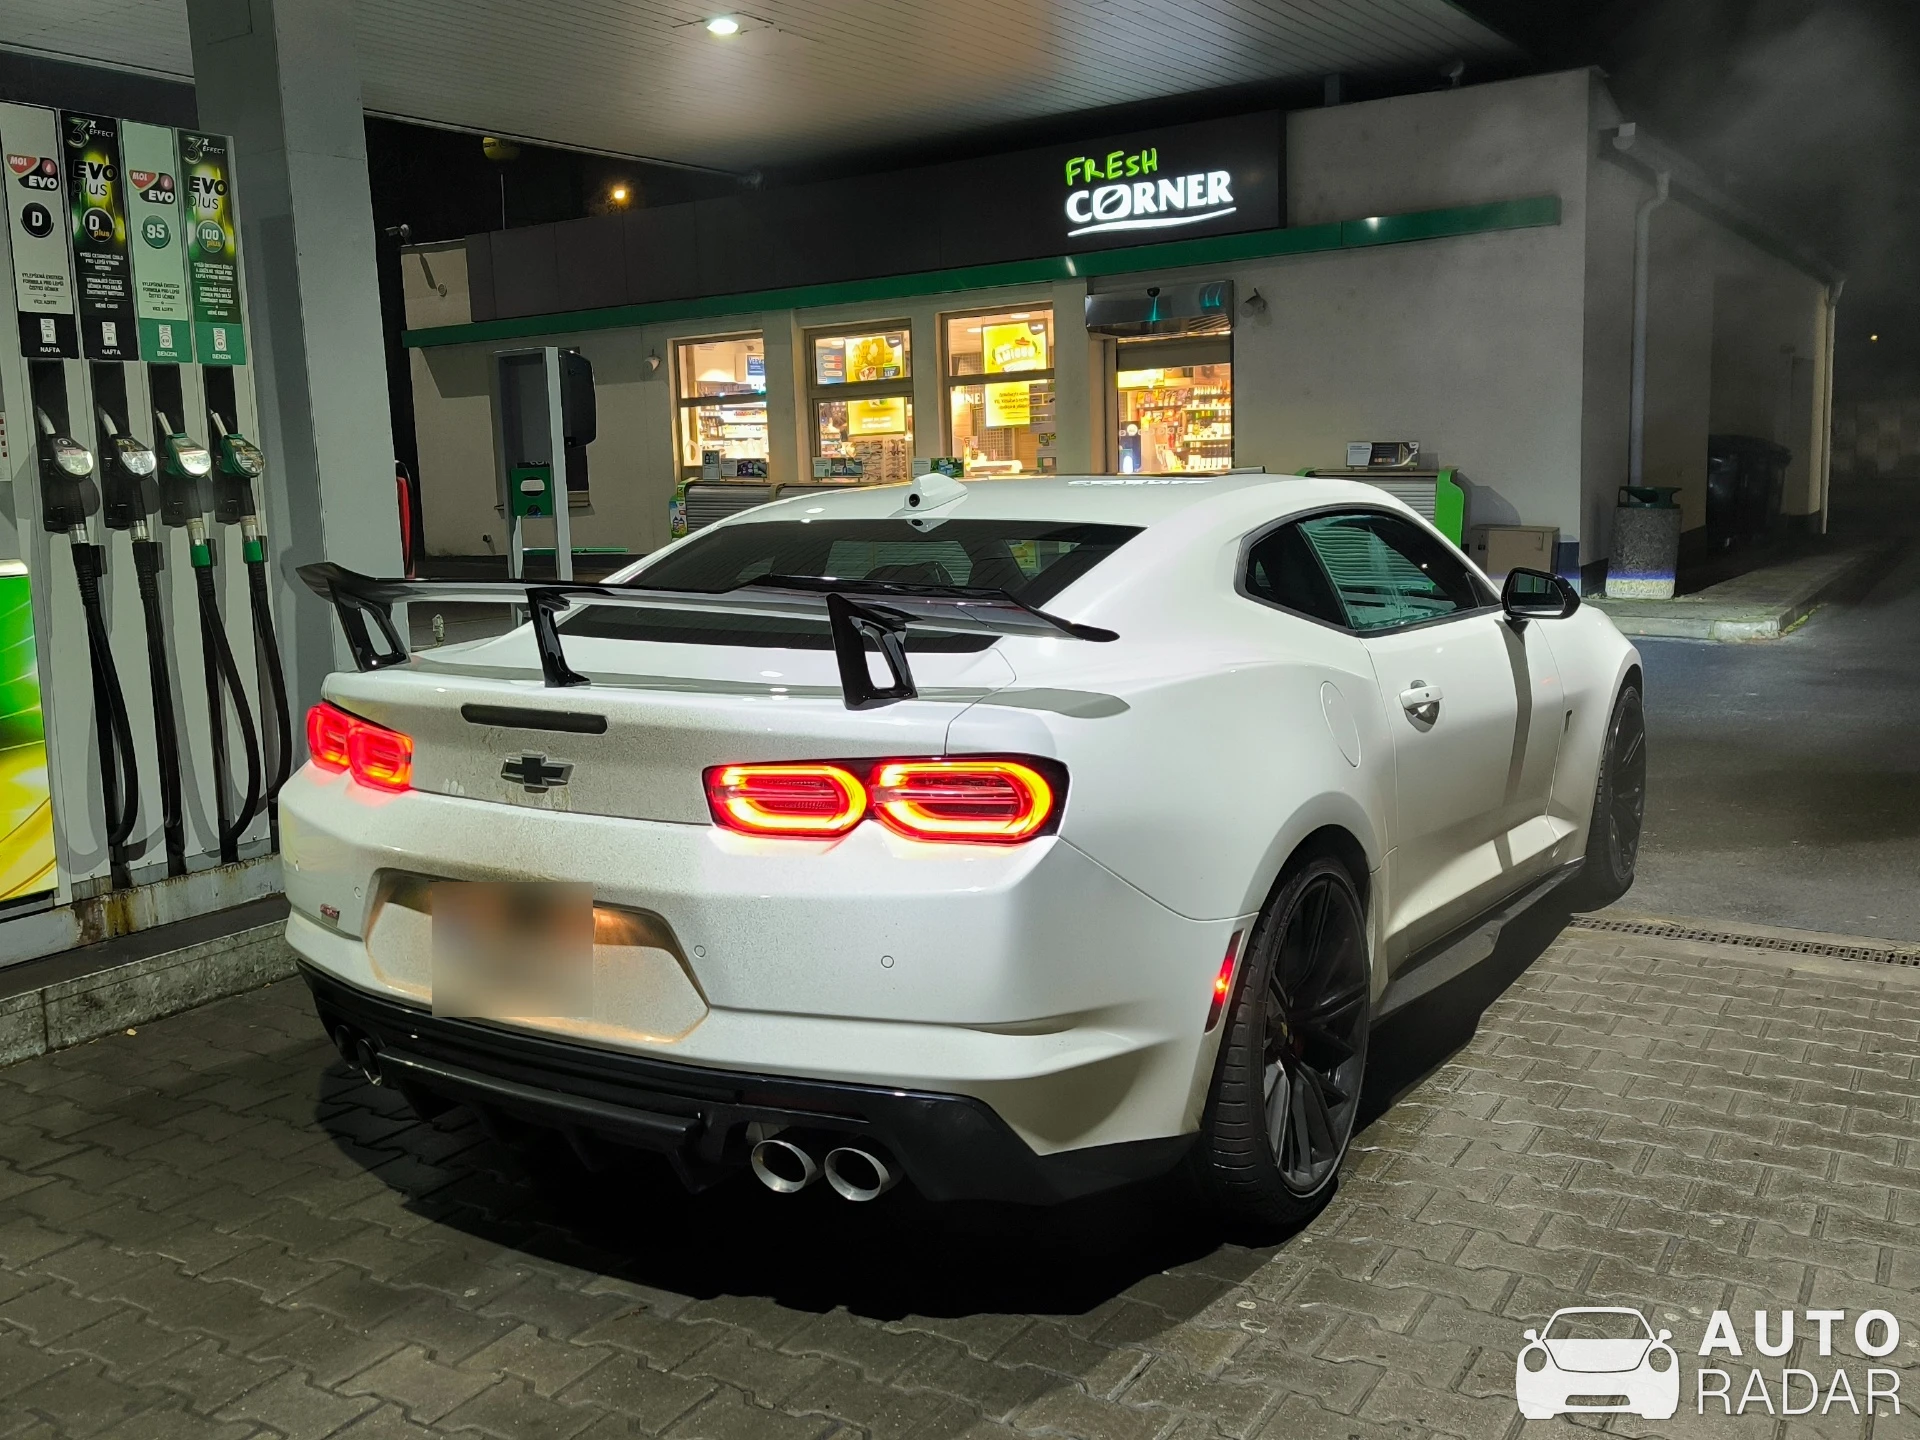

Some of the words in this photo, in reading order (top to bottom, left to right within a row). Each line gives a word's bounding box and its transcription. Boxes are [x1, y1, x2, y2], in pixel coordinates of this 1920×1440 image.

[89, 129, 115, 137] EFFECT
[73, 160, 118, 181] EVO
[1065, 148, 1158, 186] FRESH
[28, 176, 58, 189] EVO
[188, 176, 228, 196] EVO
[148, 190, 174, 203] EVO
[1066, 171, 1234, 223] CORNER
[32, 211, 43, 227] D
[89, 215, 100, 231] D
[146, 224, 165, 239] 95
[202, 228, 219, 241] 100
